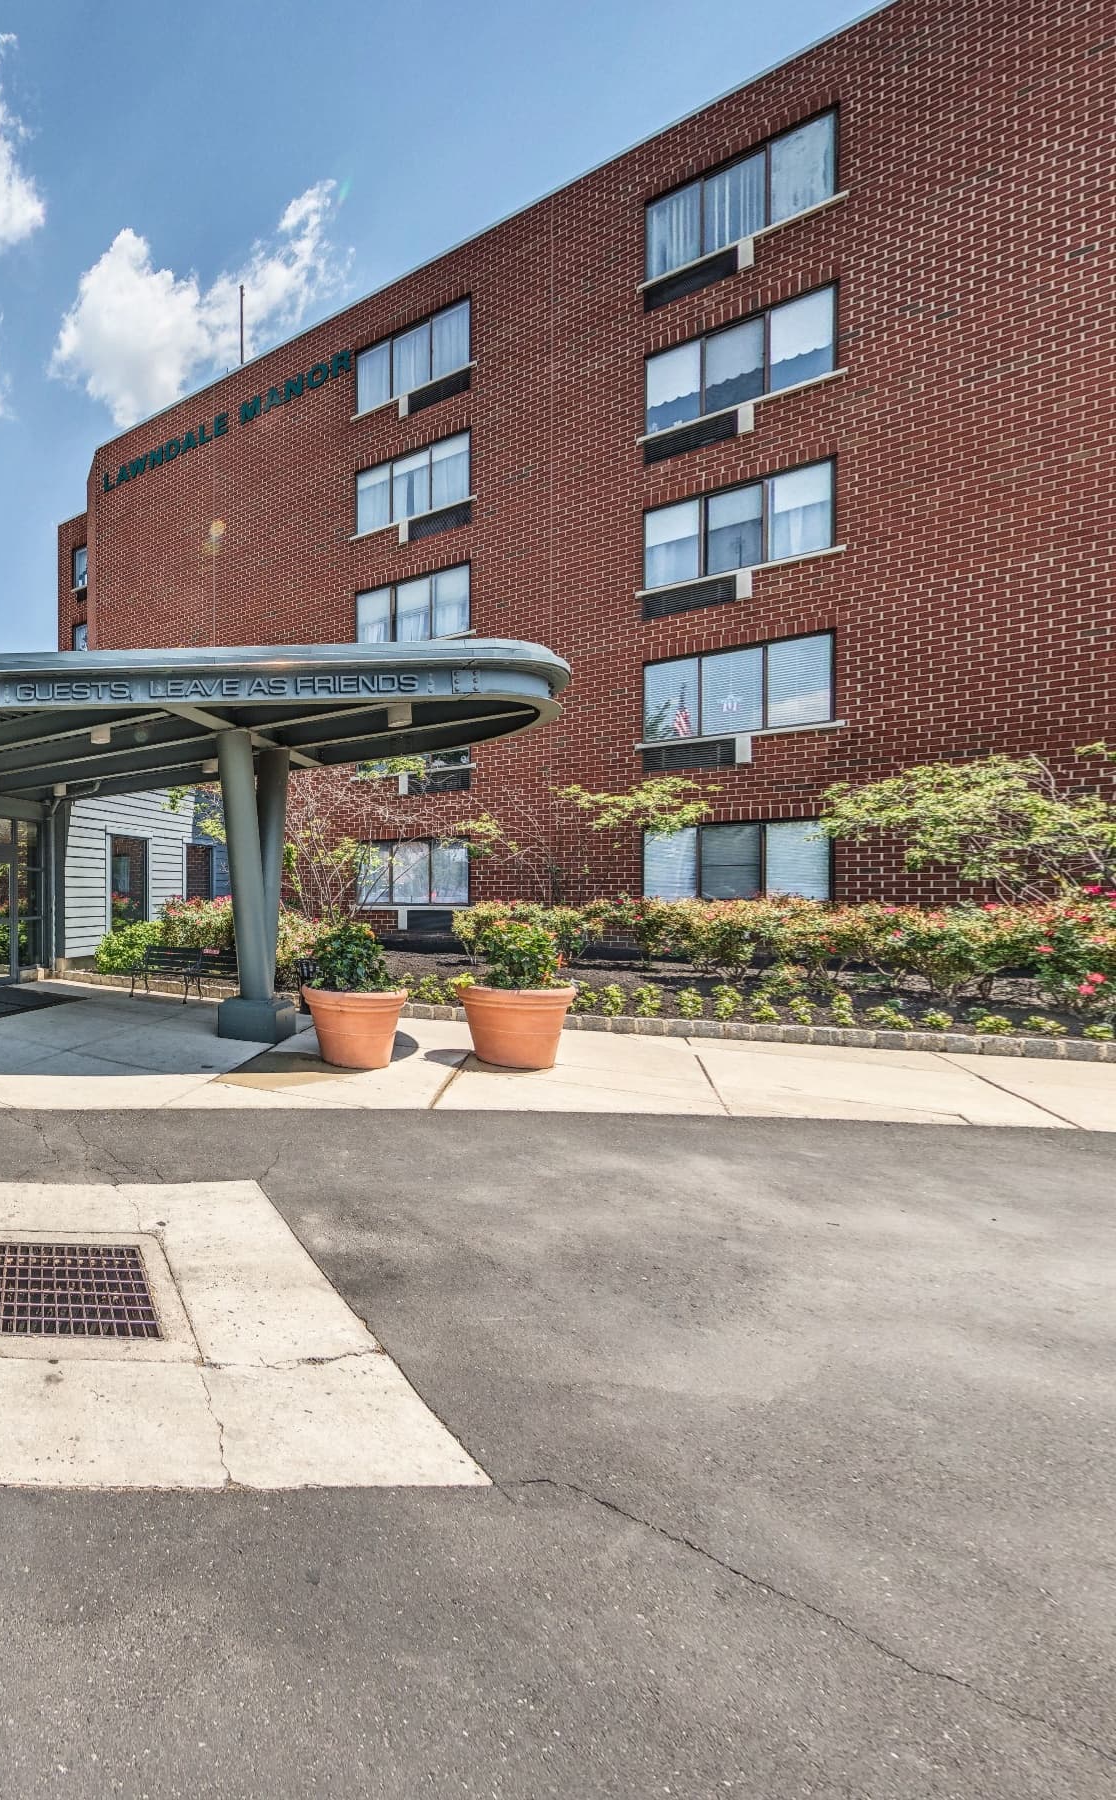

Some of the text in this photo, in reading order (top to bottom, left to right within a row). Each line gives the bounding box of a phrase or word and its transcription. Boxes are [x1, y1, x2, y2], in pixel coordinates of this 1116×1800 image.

[103, 349, 352, 493] LAWNDALE MANOR
[15, 681, 133, 702] GUESTS,
[149, 677, 240, 697] LEAVE
[248, 677, 287, 696] AS
[295, 673, 419, 695] FRIENDS
